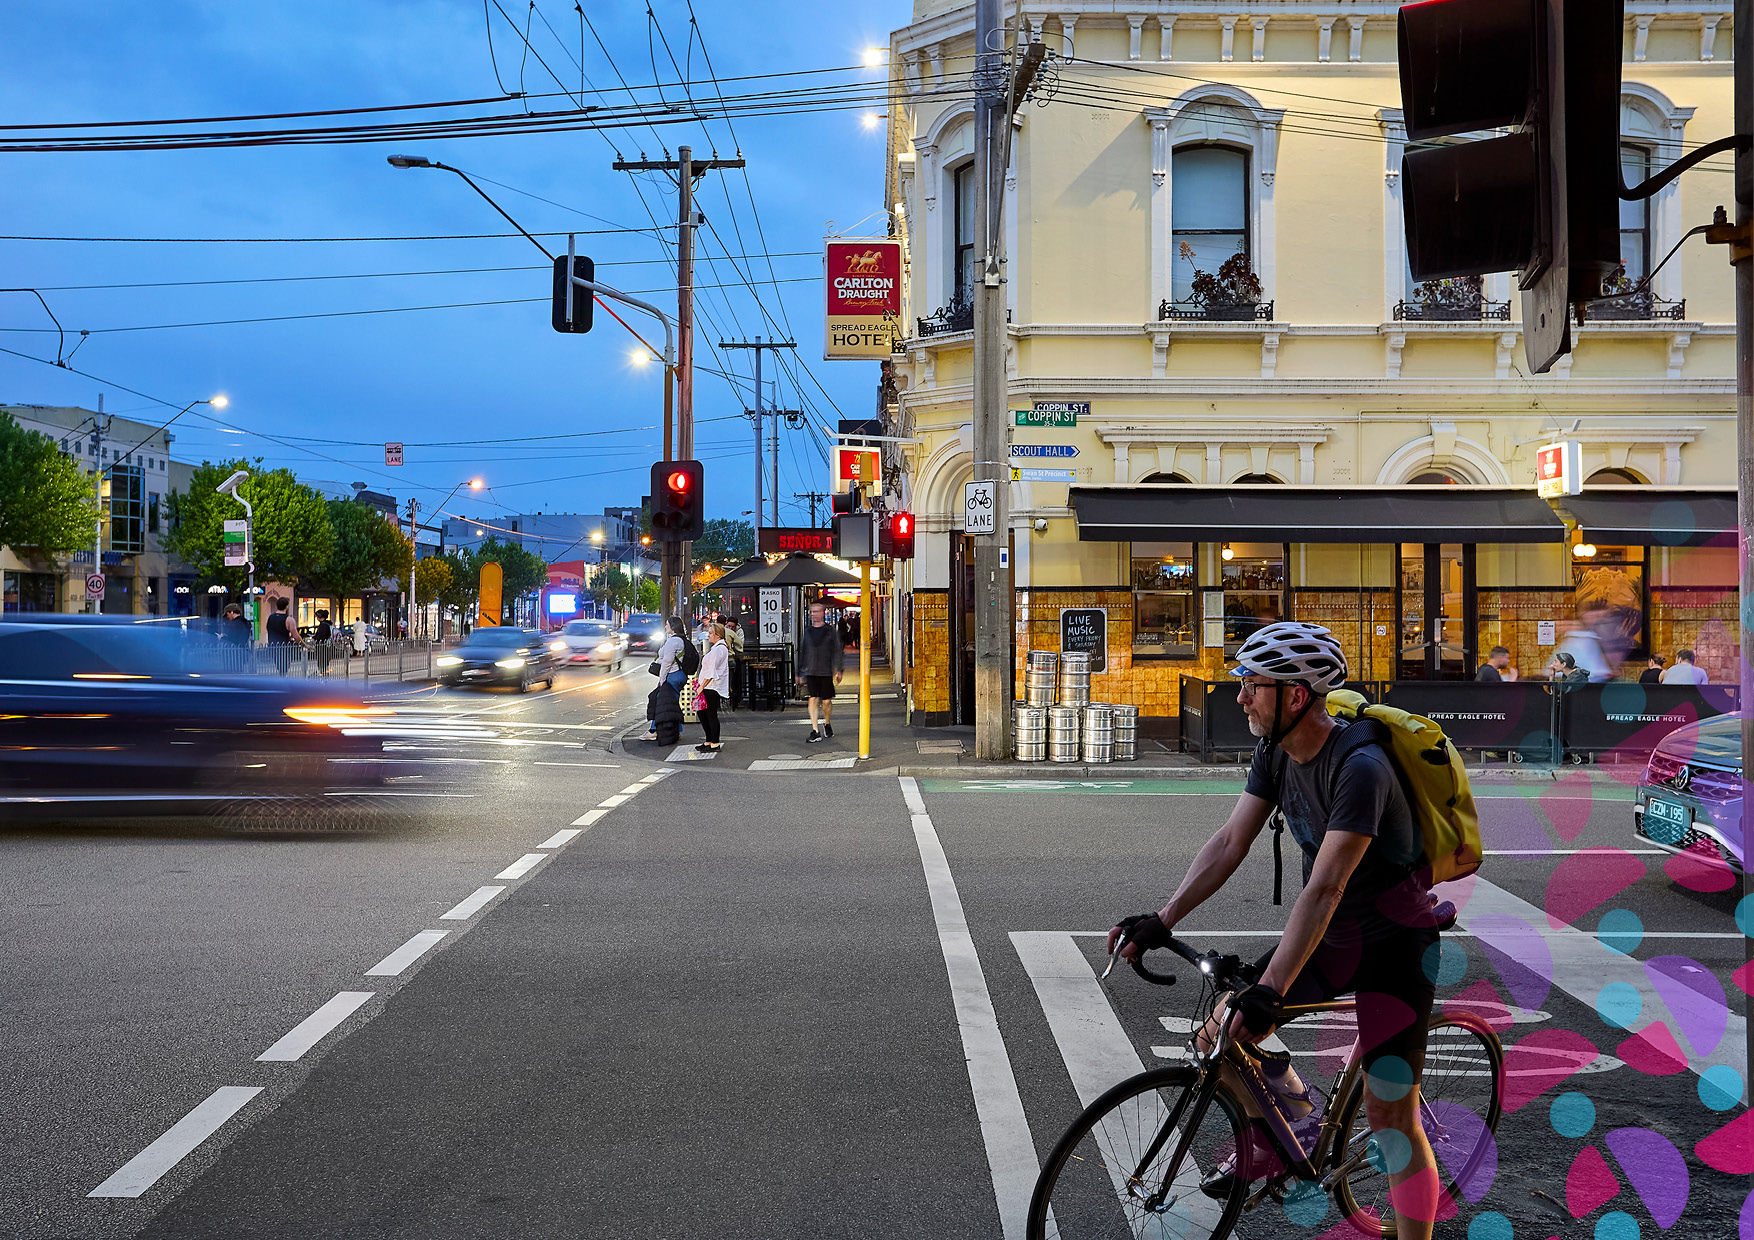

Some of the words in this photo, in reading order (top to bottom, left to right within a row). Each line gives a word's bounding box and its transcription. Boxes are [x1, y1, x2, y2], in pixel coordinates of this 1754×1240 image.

[834, 277, 893, 289] CARLTON
[838, 289, 889, 299] DRAUGHT
[1037, 403, 1068, 412] COPPIN
[1027, 411, 1061, 422] COPPIN
[1064, 411, 1075, 422] ST
[1012, 445, 1042, 456] SCOUT
[1045, 446, 1070, 456] HALL
[967, 514, 992, 527] LANE
[779, 533, 822, 550] SEÑOR
[89, 579, 102, 589] 40
[763, 599, 778, 611] 10
[1068, 615, 1092, 626] LIVE
[763, 622, 778, 634] 10
[1067, 625, 1096, 636] MUSIC
[1067, 635, 1084, 643] EVERY
